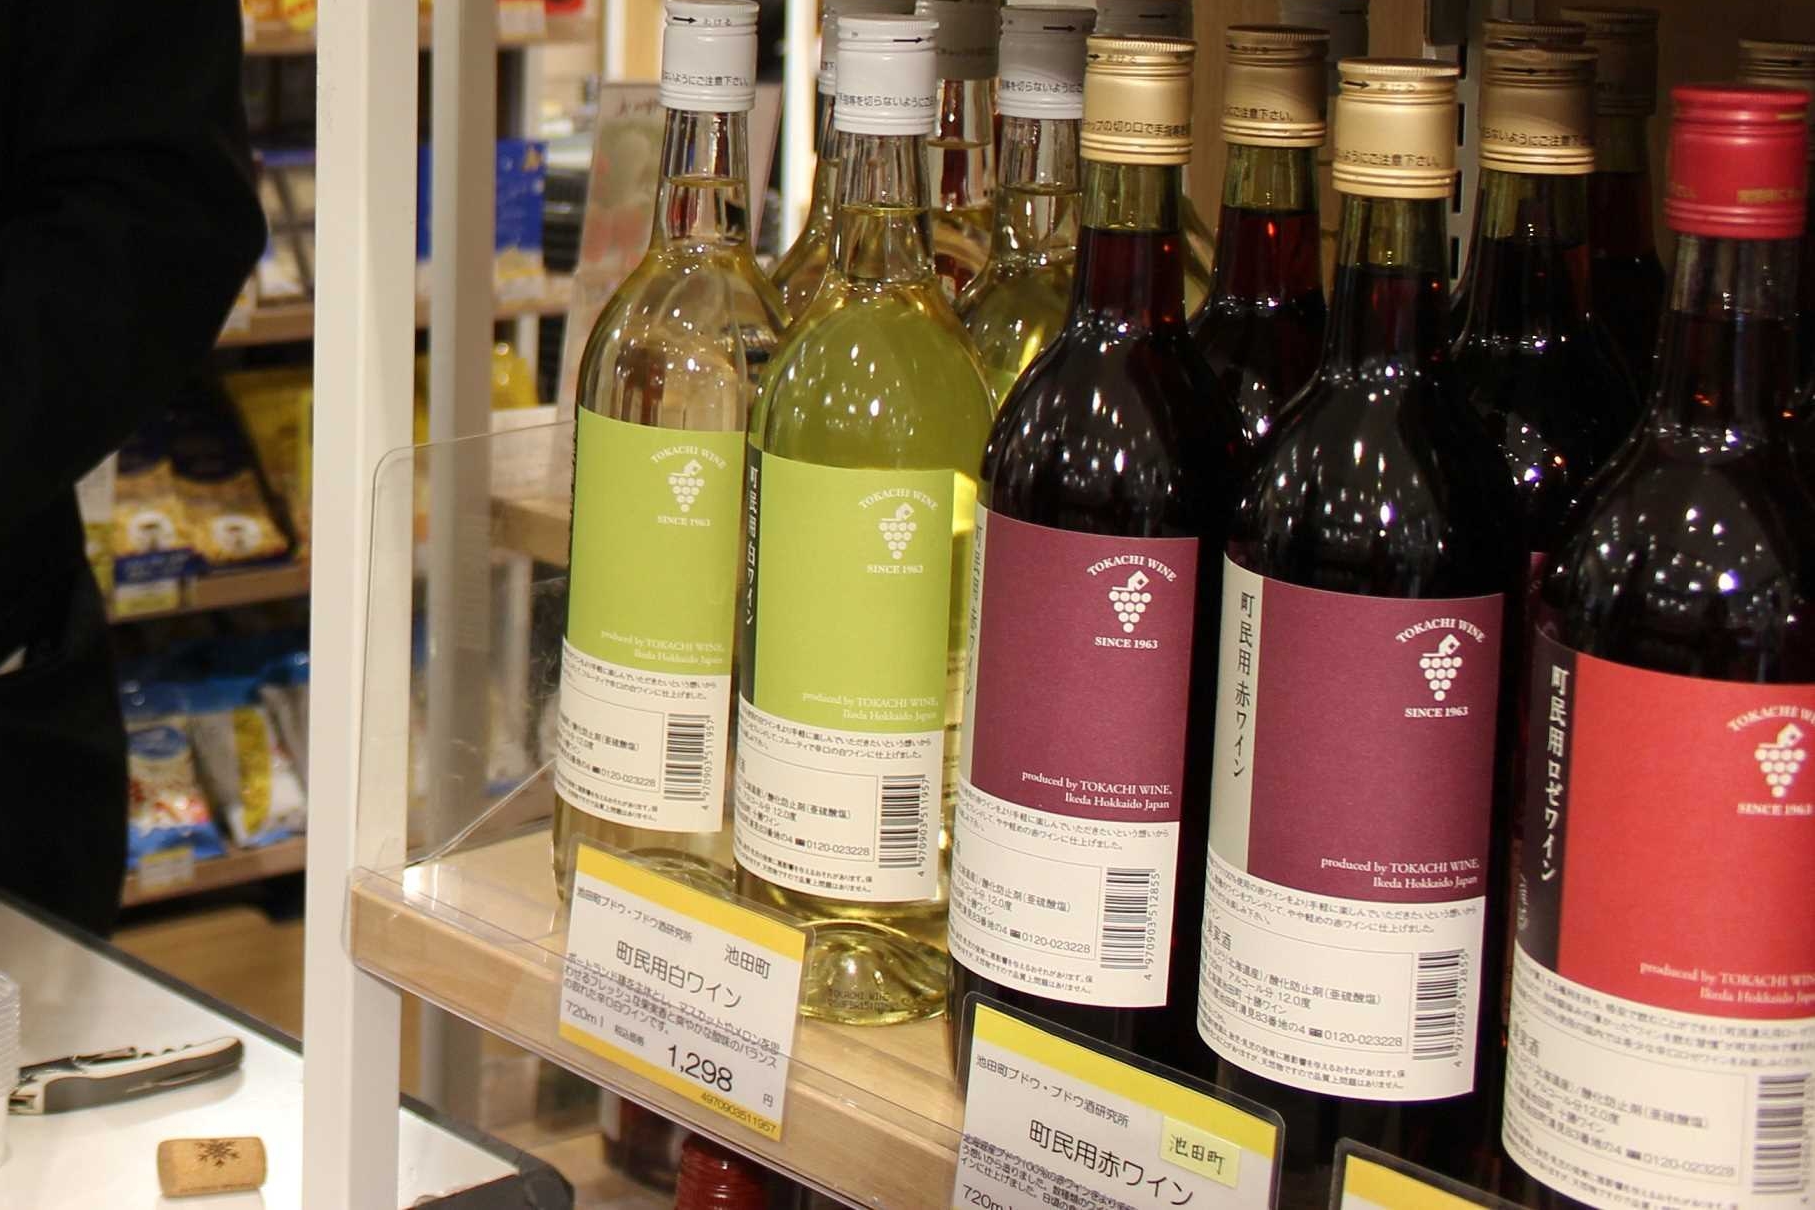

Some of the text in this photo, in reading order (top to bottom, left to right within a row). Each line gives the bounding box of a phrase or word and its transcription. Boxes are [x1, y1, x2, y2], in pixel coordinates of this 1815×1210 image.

[701, 448, 727, 470] WINE
[858, 488, 939, 511] TOKACHI WINE
[658, 515, 688, 526] SINCE
[867, 565, 901, 575] SINCE
[1086, 554, 1178, 582] TOKACHI WINE
[1395, 617, 1486, 645] TOKACHI WINE
[1094, 636, 1159, 650] SINCE 1963
[1233, 592, 1256, 780] 町民用赤ワイン
[857, 697, 907, 708] TOKACHI
[1404, 706, 1469, 718] SINCE 1963
[1726, 705, 1787, 732] TOKACHI
[1021, 770, 1173, 796] produced by TOKACHI WINE.
[1540, 664, 1570, 882] 町民用ロゼワイン
[1065, 792, 1170, 812] Ikeda Hokkaido Japan
[1737, 802, 1781, 816] SINCE
[806, 839, 870, 856] 0120-023228
[1320, 857, 1371, 873] produced
[1373, 860, 1387, 875] by
[1389, 861, 1448, 874] TOKACHI
[1373, 874, 1479, 890] Ikeda Hokkaido Japan
[724, 943, 772, 981] 池田町
[616, 939, 743, 1009] 町民用白ワイン
[1639, 961, 1699, 982] produced
[1700, 968, 1716, 986] by
[1720, 972, 1788, 988] TOKACHI
[1737, 988, 1795, 1005] Hokkaido
[1324, 1029, 1403, 1047] 0120-023228
[667, 1043, 735, 1094] 1,298
[762, 1092, 775, 1109] 円
[976, 1054, 1227, 1176] 池田町ブドウ・ブドウ酒研究所 池田町
[1029, 1118, 1195, 1208] 町民用赤ワイン
